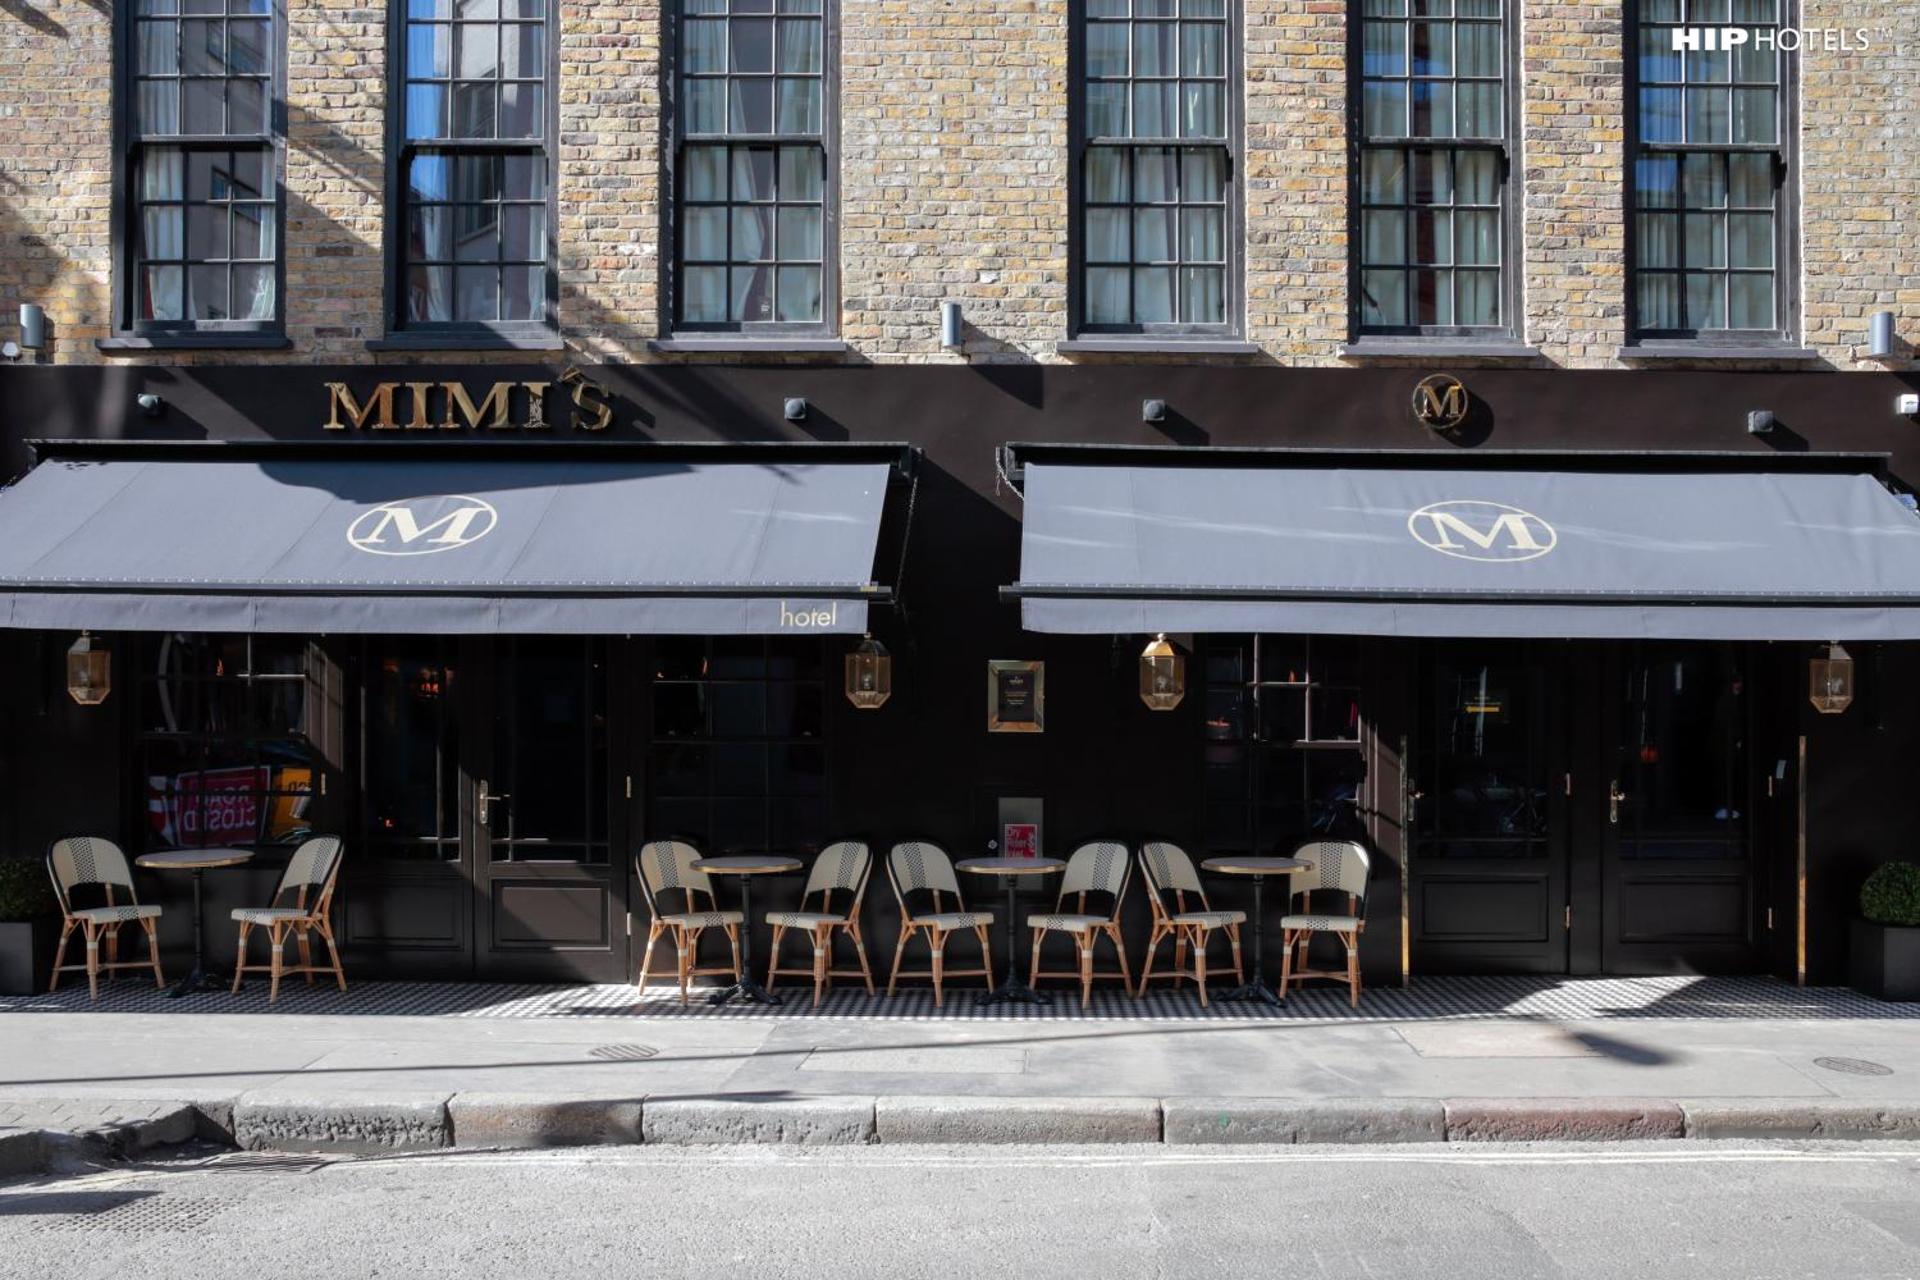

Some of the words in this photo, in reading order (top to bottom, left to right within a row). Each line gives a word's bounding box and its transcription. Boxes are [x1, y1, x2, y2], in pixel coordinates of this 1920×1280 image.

[1416, 385, 1463, 418] M
[353, 507, 490, 543] M
[1413, 512, 1550, 549] M
[780, 601, 836, 627] hotel
